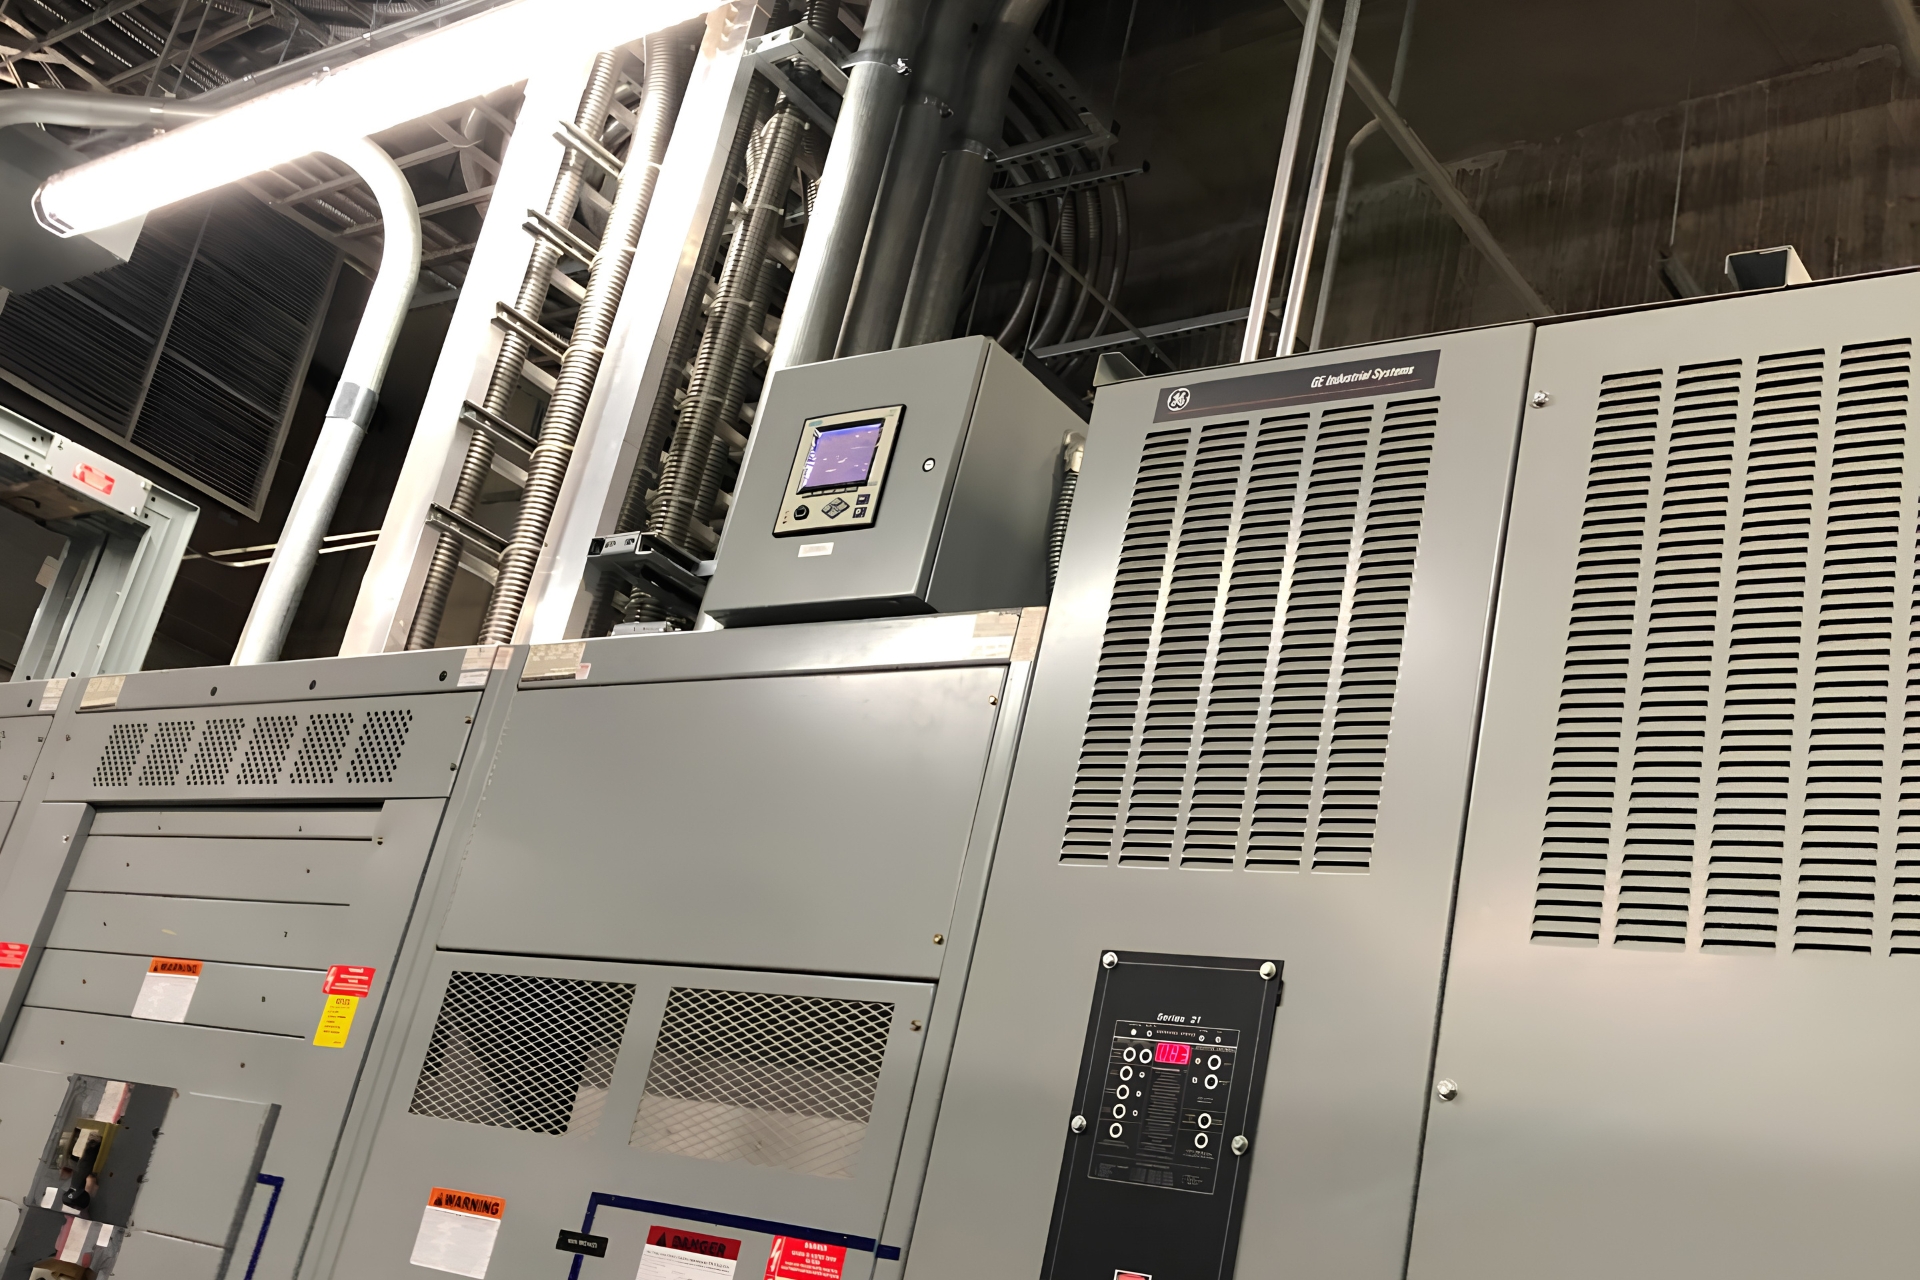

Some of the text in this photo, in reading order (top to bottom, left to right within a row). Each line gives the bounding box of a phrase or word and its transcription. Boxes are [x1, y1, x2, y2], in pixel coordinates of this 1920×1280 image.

[1311, 366, 1415, 388] GE Industrial Systems
[445, 1193, 500, 1216] WARNING
[671, 1234, 727, 1258] DANGER
